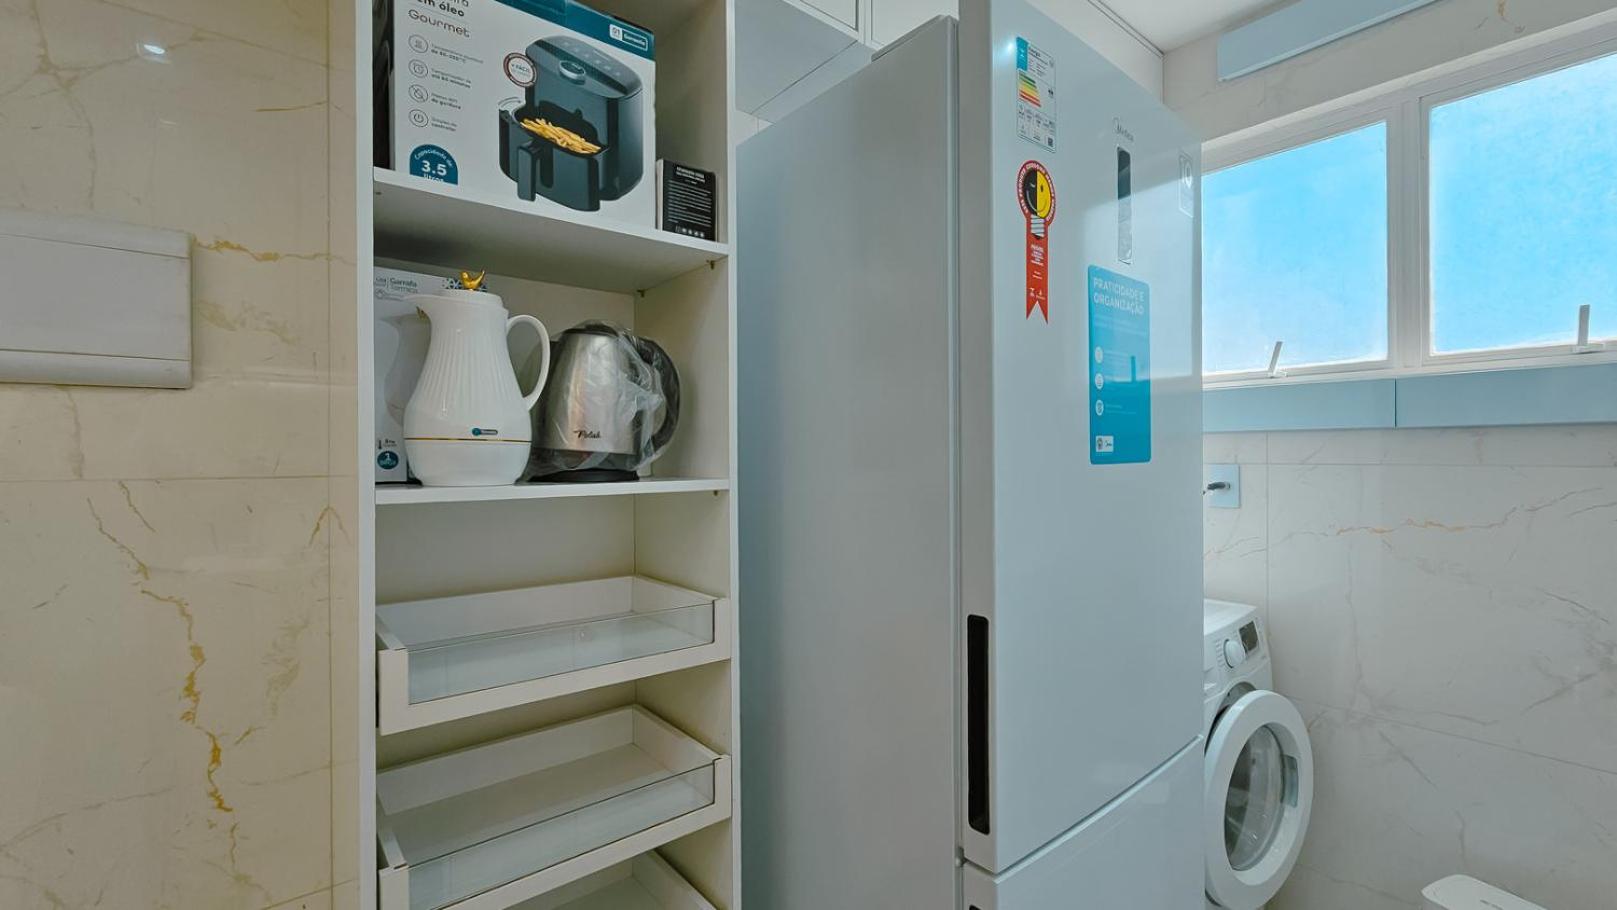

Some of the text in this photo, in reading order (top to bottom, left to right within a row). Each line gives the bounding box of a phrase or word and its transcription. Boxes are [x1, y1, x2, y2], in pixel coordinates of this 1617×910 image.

[439, 1, 465, 17] óleo
[408, 9, 470, 38] Gourmet
[421, 160, 447, 176] 3.5
[1093, 291, 1145, 316] ORGANIZAÇÃO
